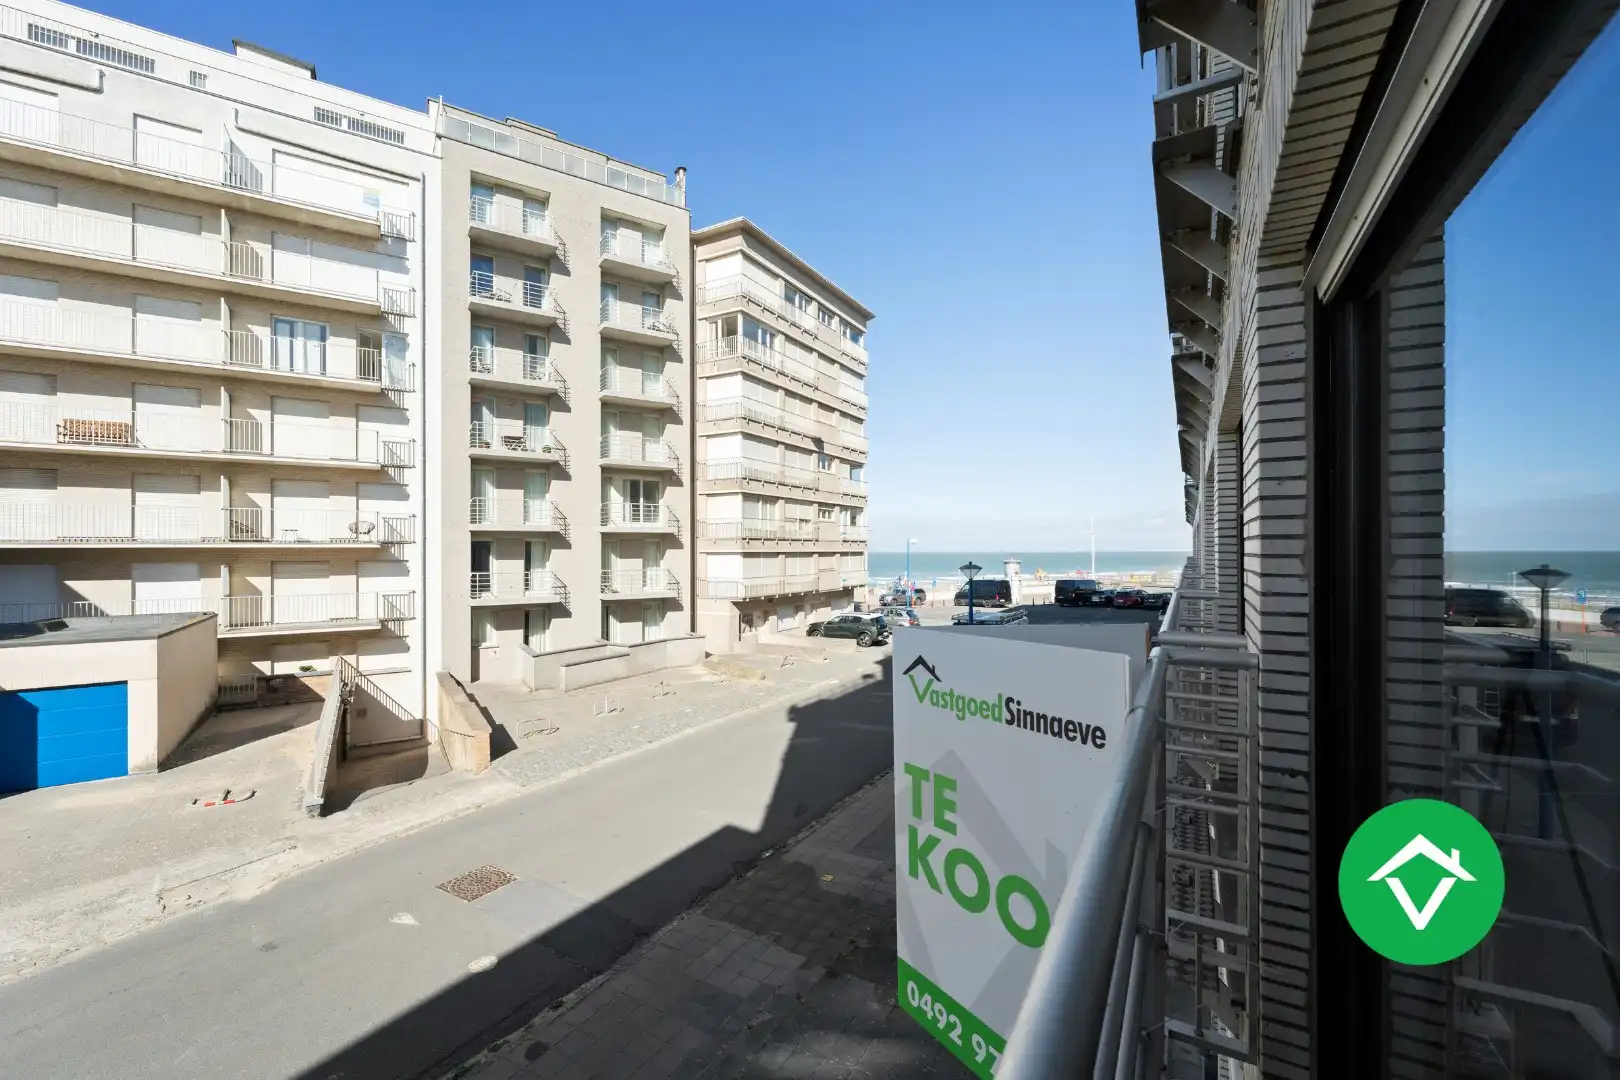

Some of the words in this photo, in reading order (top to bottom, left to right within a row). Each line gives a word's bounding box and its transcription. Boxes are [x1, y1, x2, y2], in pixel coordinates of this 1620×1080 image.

[904, 762, 957, 836] TE
[908, 824, 1050, 949] KOO
[907, 980, 963, 1047] 0492
